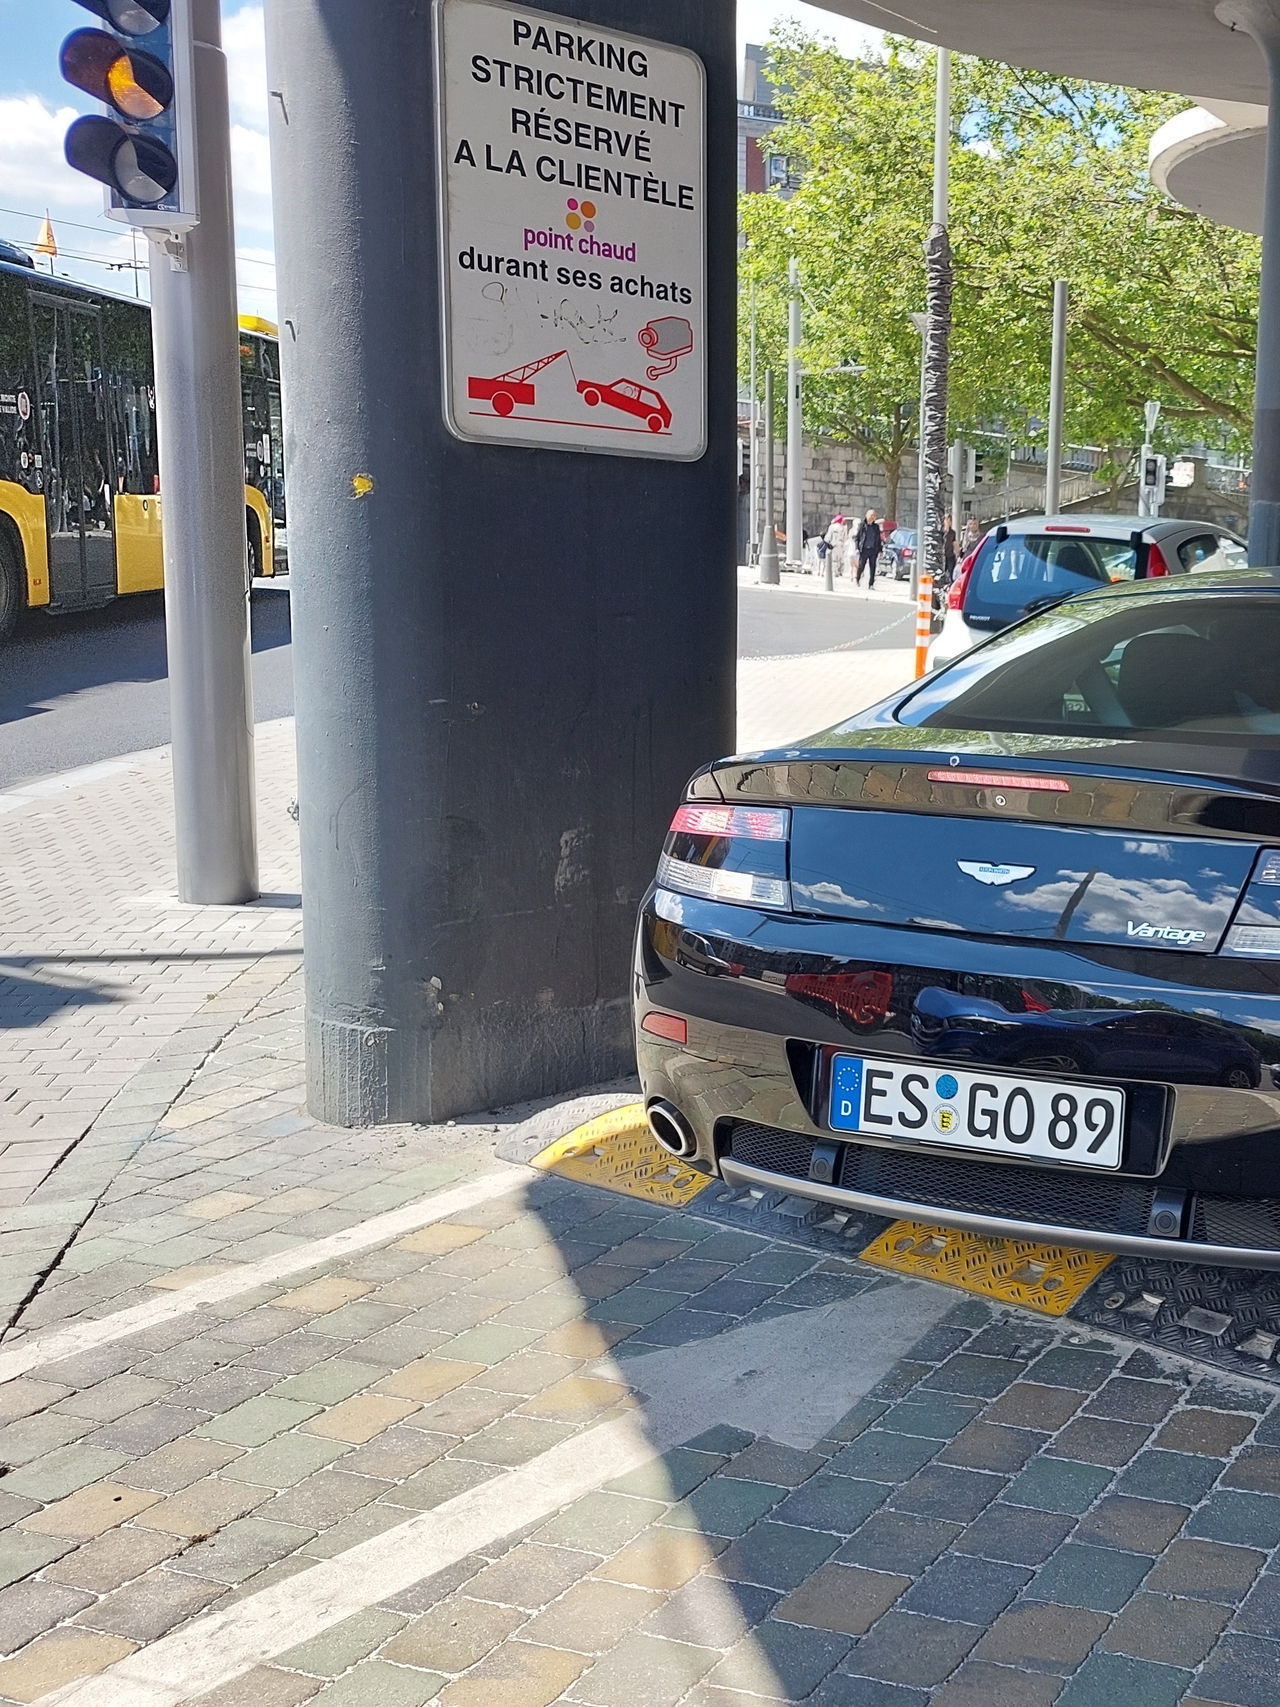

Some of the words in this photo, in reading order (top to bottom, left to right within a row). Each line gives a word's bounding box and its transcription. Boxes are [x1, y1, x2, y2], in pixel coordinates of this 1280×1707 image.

[512, 19, 648, 78] PARKING
[471, 55, 685, 128] STRICTEMENT
[511, 107, 651, 162] RÉSERVÉ
[453, 139, 477, 168] A
[485, 144, 527, 178] LA
[536, 155, 695, 211] CLIENTÈLE
[523, 227, 574, 251] point
[578, 234, 637, 262] chaud
[458, 246, 549, 282] durant
[556, 265, 602, 290] ses
[610, 275, 693, 304] achats
[1126, 920, 1207, 945] Vantage
[840, 1100, 853, 1117] D
[863, 1068, 930, 1129] ES
[966, 1083, 1035, 1144] GO
[1047, 1093, 1115, 1154] 89
